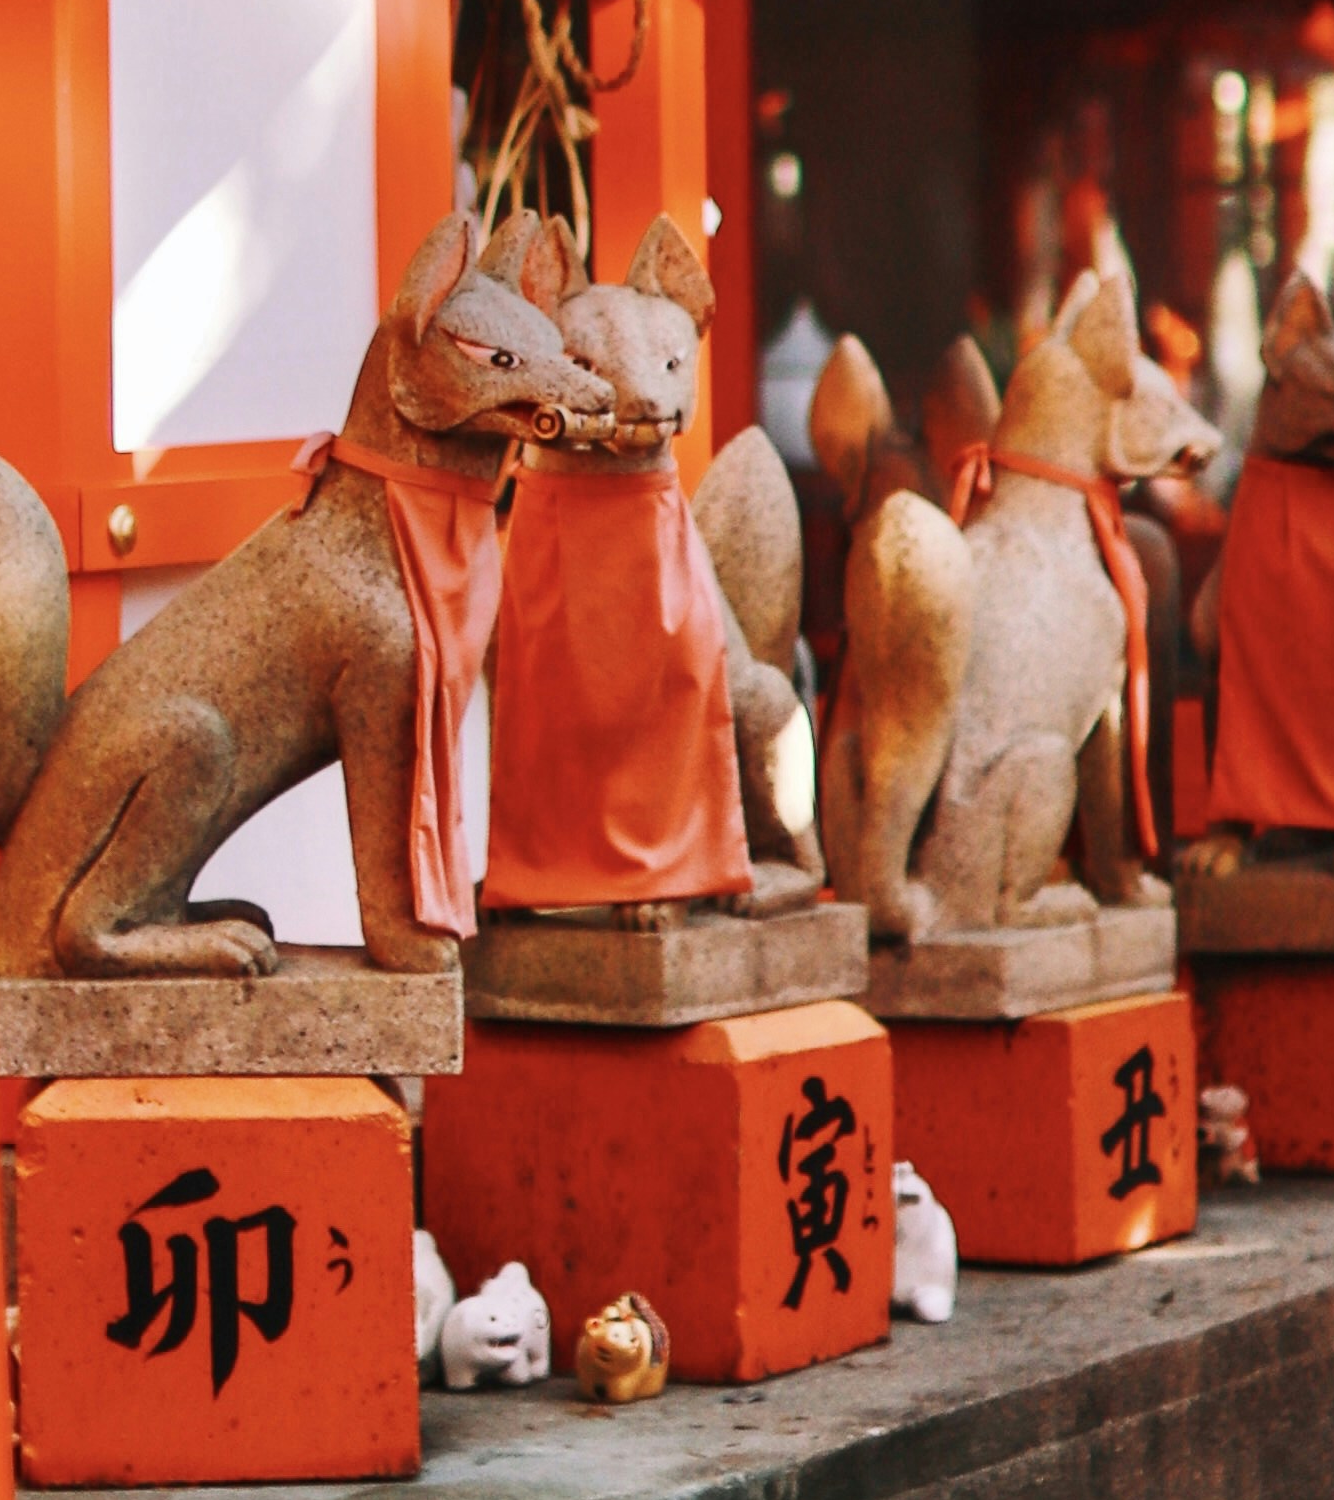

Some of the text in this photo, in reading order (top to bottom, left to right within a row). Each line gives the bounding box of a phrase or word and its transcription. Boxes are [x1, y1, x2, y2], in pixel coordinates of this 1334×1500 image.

[777, 1074, 857, 1312] 寅
[1099, 1043, 1166, 1202] 丑
[104, 1166, 298, 1402] 卯
[326, 1225, 355, 1297] う
